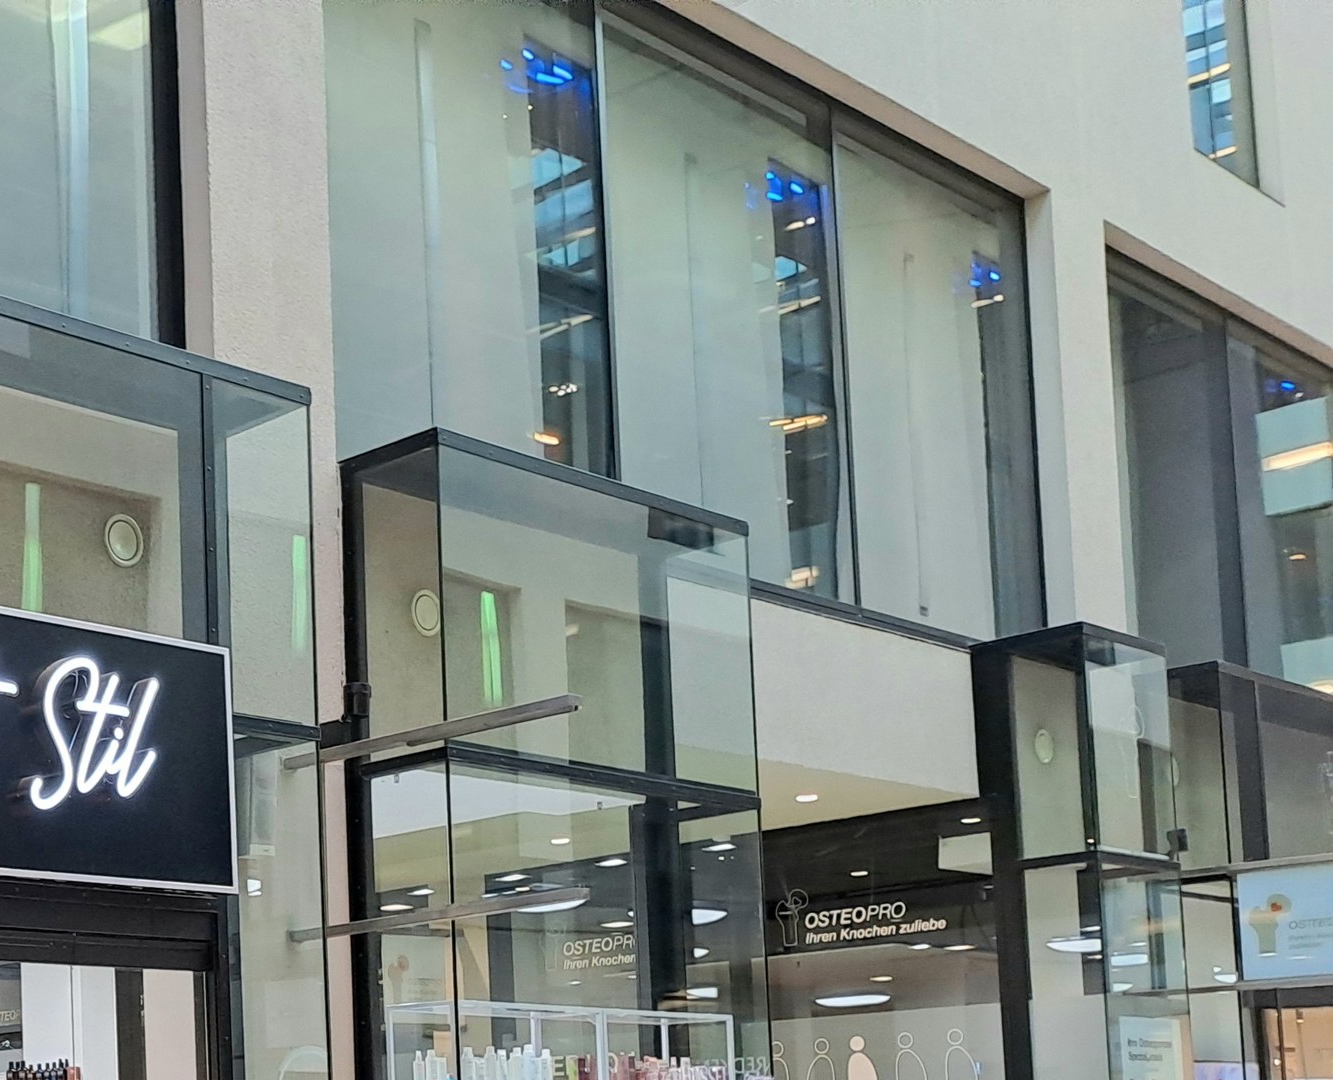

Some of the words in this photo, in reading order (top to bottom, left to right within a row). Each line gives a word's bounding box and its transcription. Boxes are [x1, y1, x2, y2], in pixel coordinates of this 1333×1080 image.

[29, 656, 159, 811] Stil
[804, 901, 907, 930] OSTEOPRO
[805, 931, 837, 945] Ihren
[840, 927, 897, 942] Knochen
[898, 917, 948, 935] zuliebe
